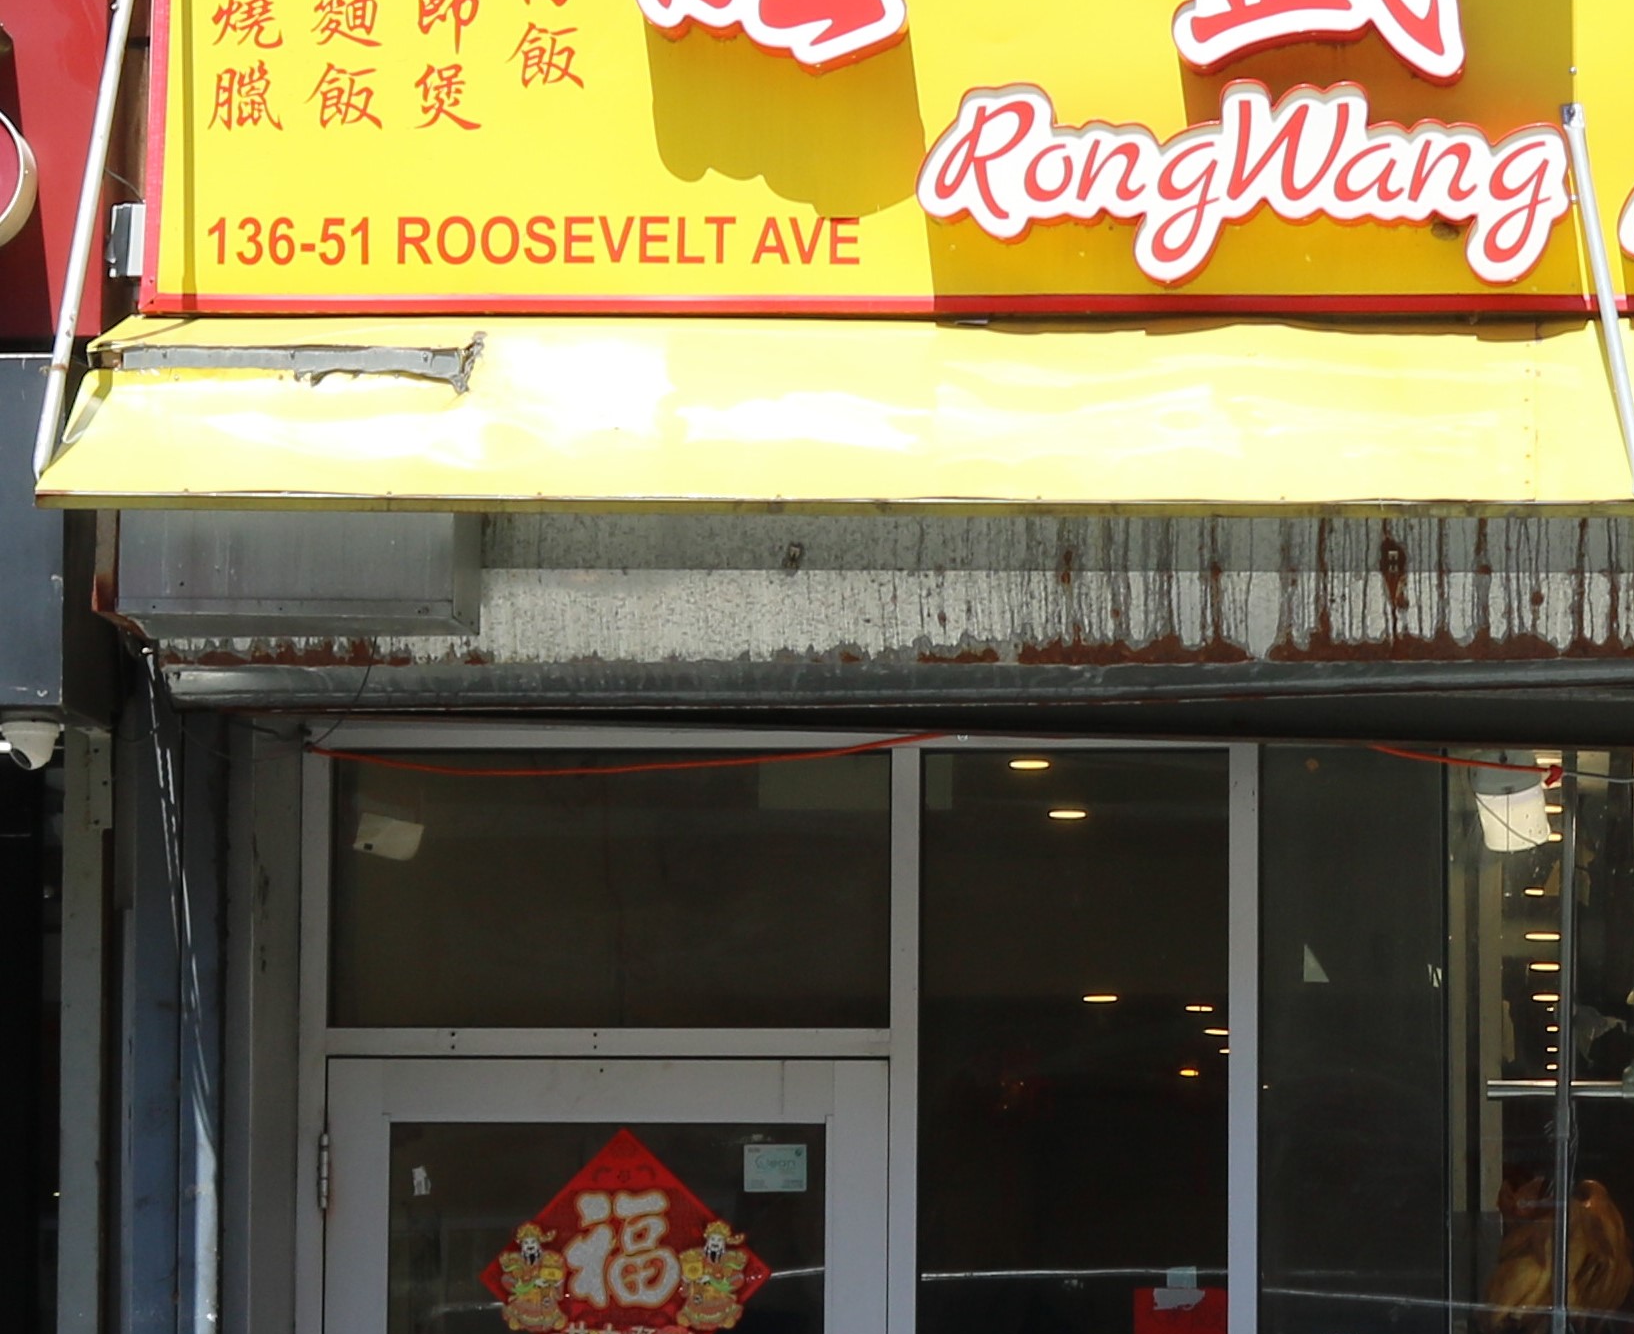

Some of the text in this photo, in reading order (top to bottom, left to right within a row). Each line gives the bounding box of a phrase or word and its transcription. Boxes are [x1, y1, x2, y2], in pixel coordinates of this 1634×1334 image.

[206, 215, 862, 266] 136-51 ROOSEVELT AVE
[916, 78, 1571, 287] RongWang
[564, 1189, 682, 1309] 福
